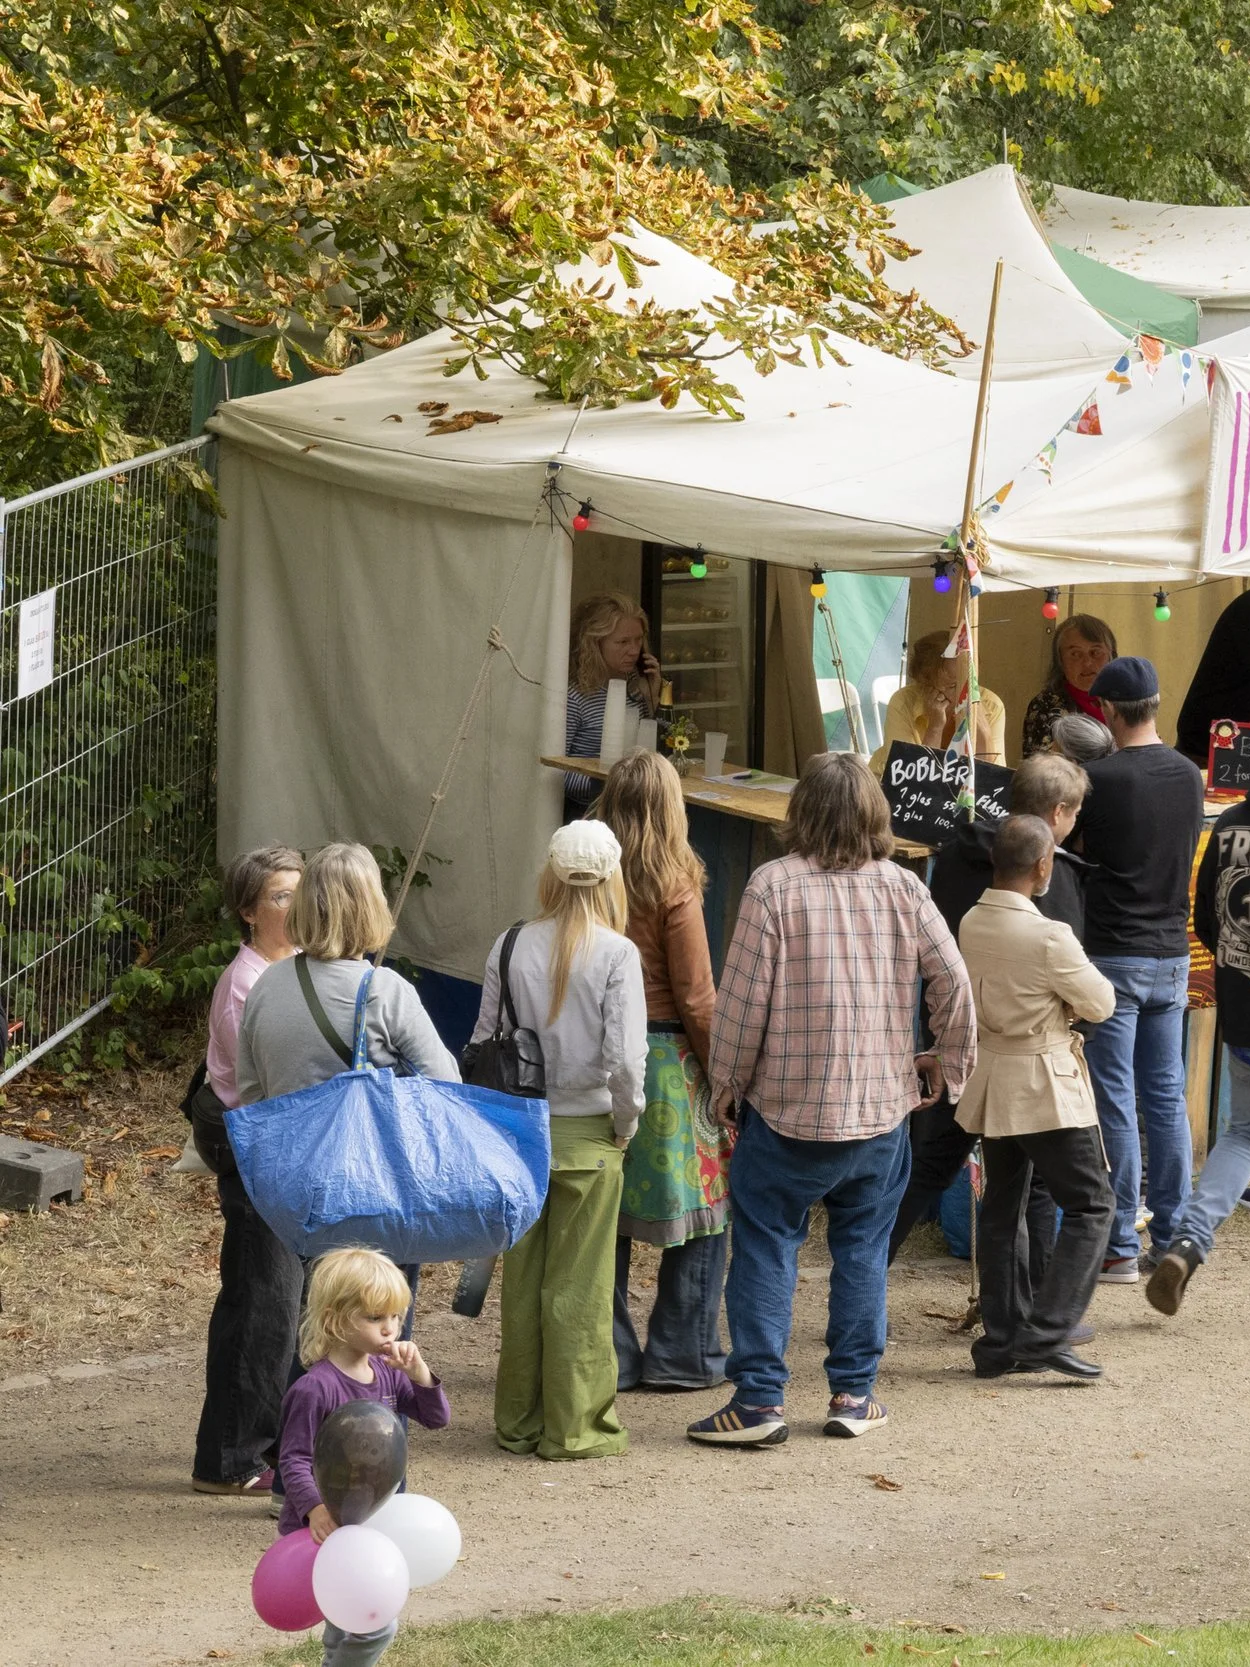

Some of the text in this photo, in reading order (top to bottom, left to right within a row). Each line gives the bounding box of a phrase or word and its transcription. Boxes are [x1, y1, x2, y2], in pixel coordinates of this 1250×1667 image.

[890, 756, 969, 786] BOBLER
[1219, 764, 1231, 782] 2
[907, 792, 932, 808] glas
[893, 805, 901, 817] 2
[903, 811, 923, 822] glas
